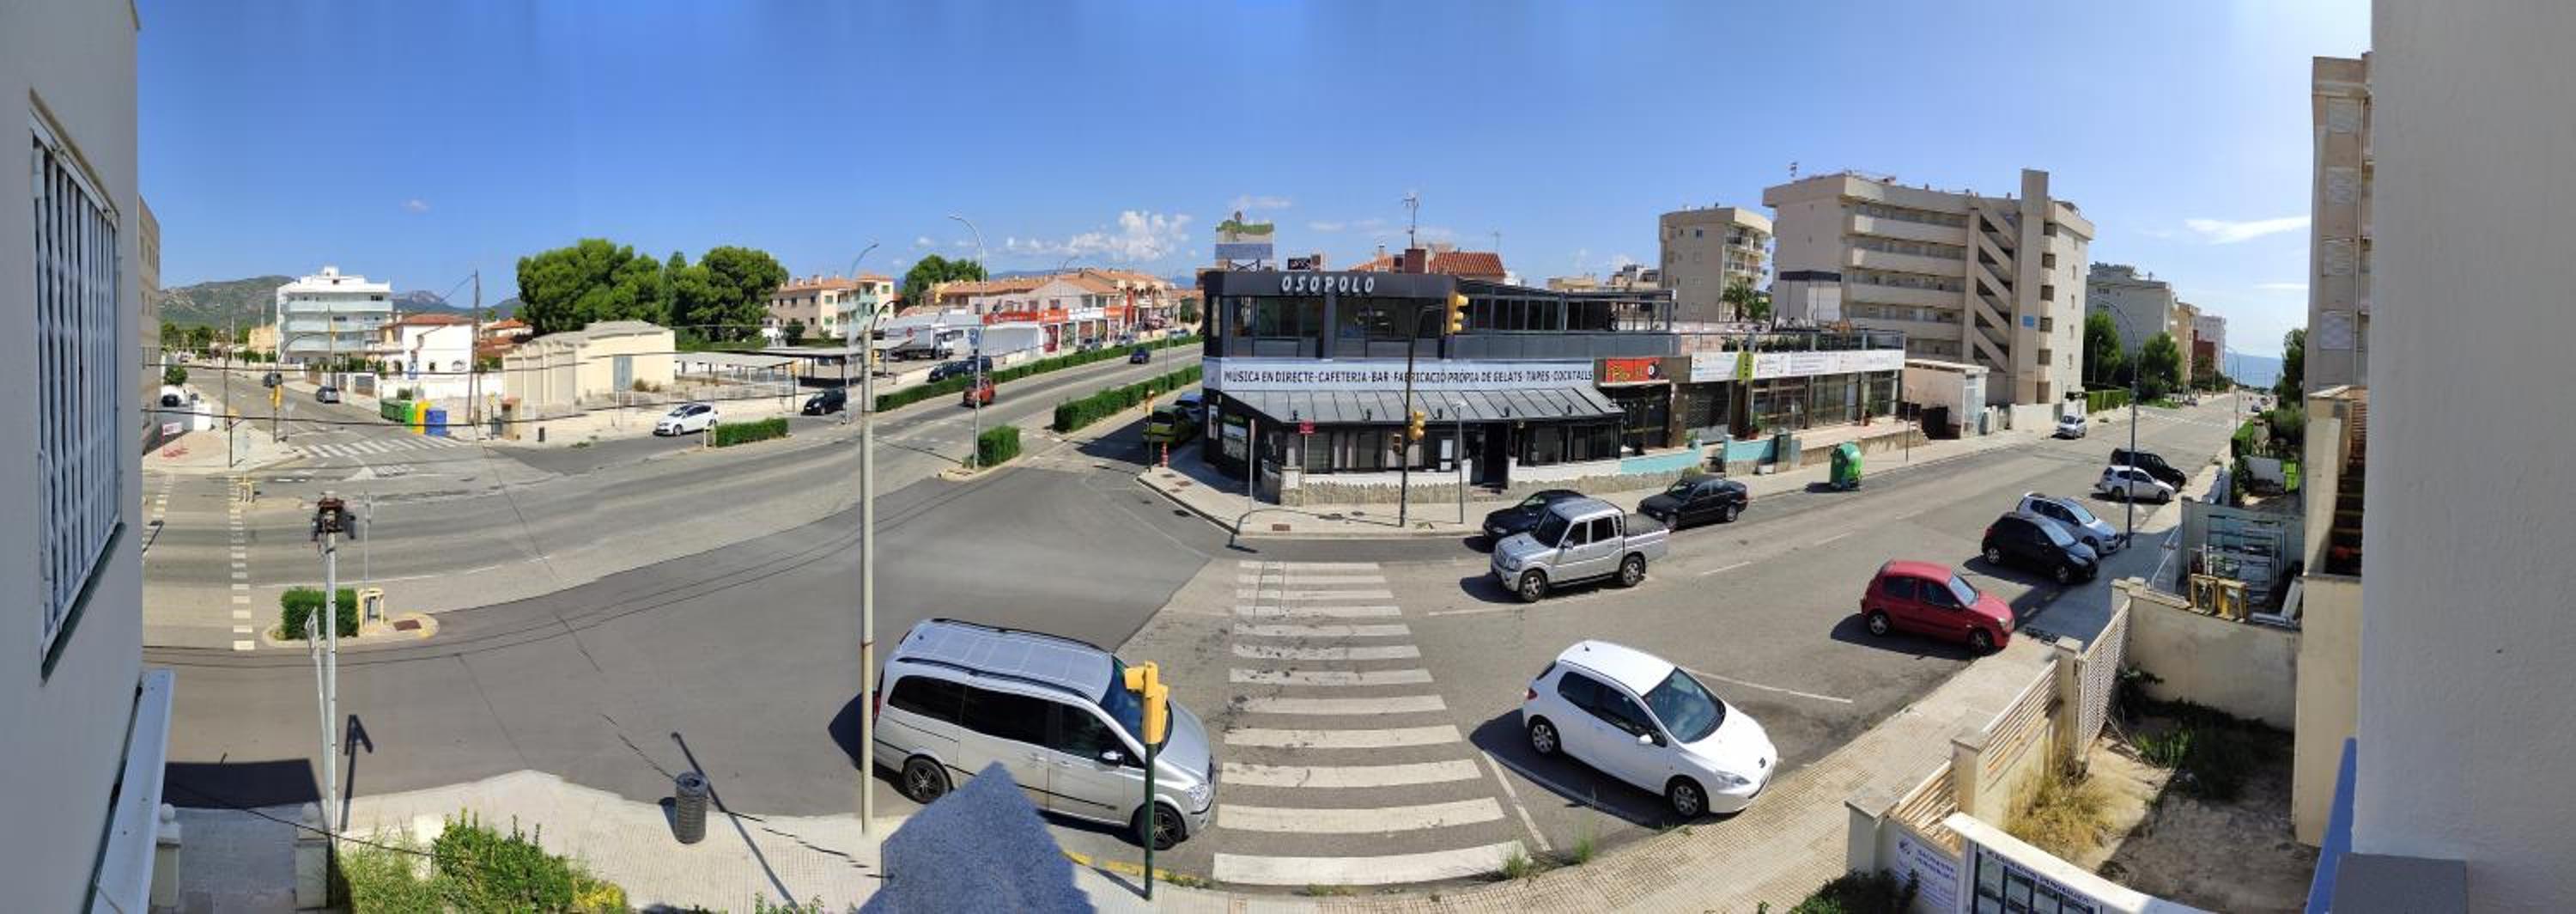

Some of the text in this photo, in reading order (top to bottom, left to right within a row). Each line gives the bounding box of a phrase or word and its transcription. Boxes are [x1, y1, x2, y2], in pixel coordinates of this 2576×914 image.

[1281, 276, 1374, 293] OSOPOLO
[1262, 371, 1273, 382] EN
[1276, 371, 1315, 383] DIRECTE
[1318, 370, 1367, 382] CAFETERIA
[1372, 370, 1388, 382] BAR
[1481, 371, 1492, 382] DE
[1494, 370, 1522, 382] GELATS
[1526, 370, 1550, 381] TAPES
[1553, 369, 1593, 381] COCKTAILS
